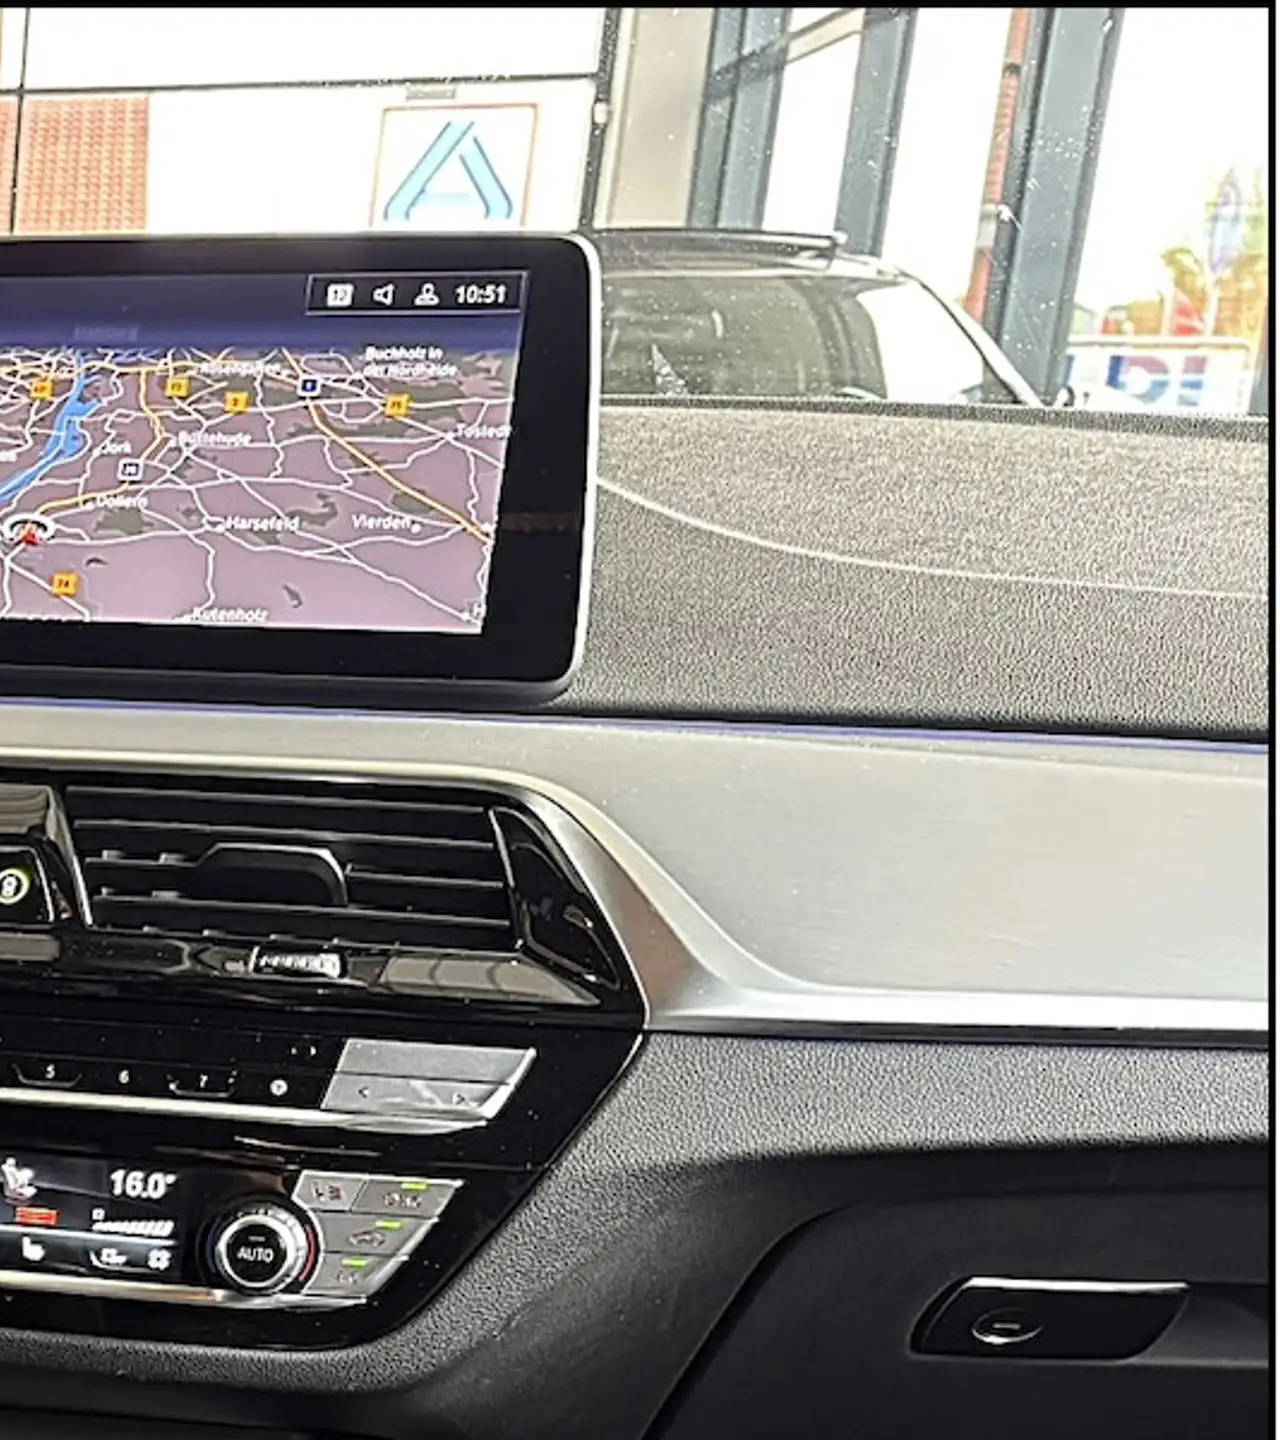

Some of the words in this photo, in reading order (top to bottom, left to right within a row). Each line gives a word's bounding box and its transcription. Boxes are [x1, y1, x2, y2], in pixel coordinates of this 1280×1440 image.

[455, 285, 506, 304] 10:51
[226, 515, 300, 531] Harsefeld
[351, 515, 412, 530] Vierden
[45, 1064, 57, 1080] 5
[118, 1070, 130, 1085] 6
[198, 1074, 210, 1089] 7
[110, 1168, 178, 1200] 16.0°
[240, 1246, 275, 1264] AUTO
